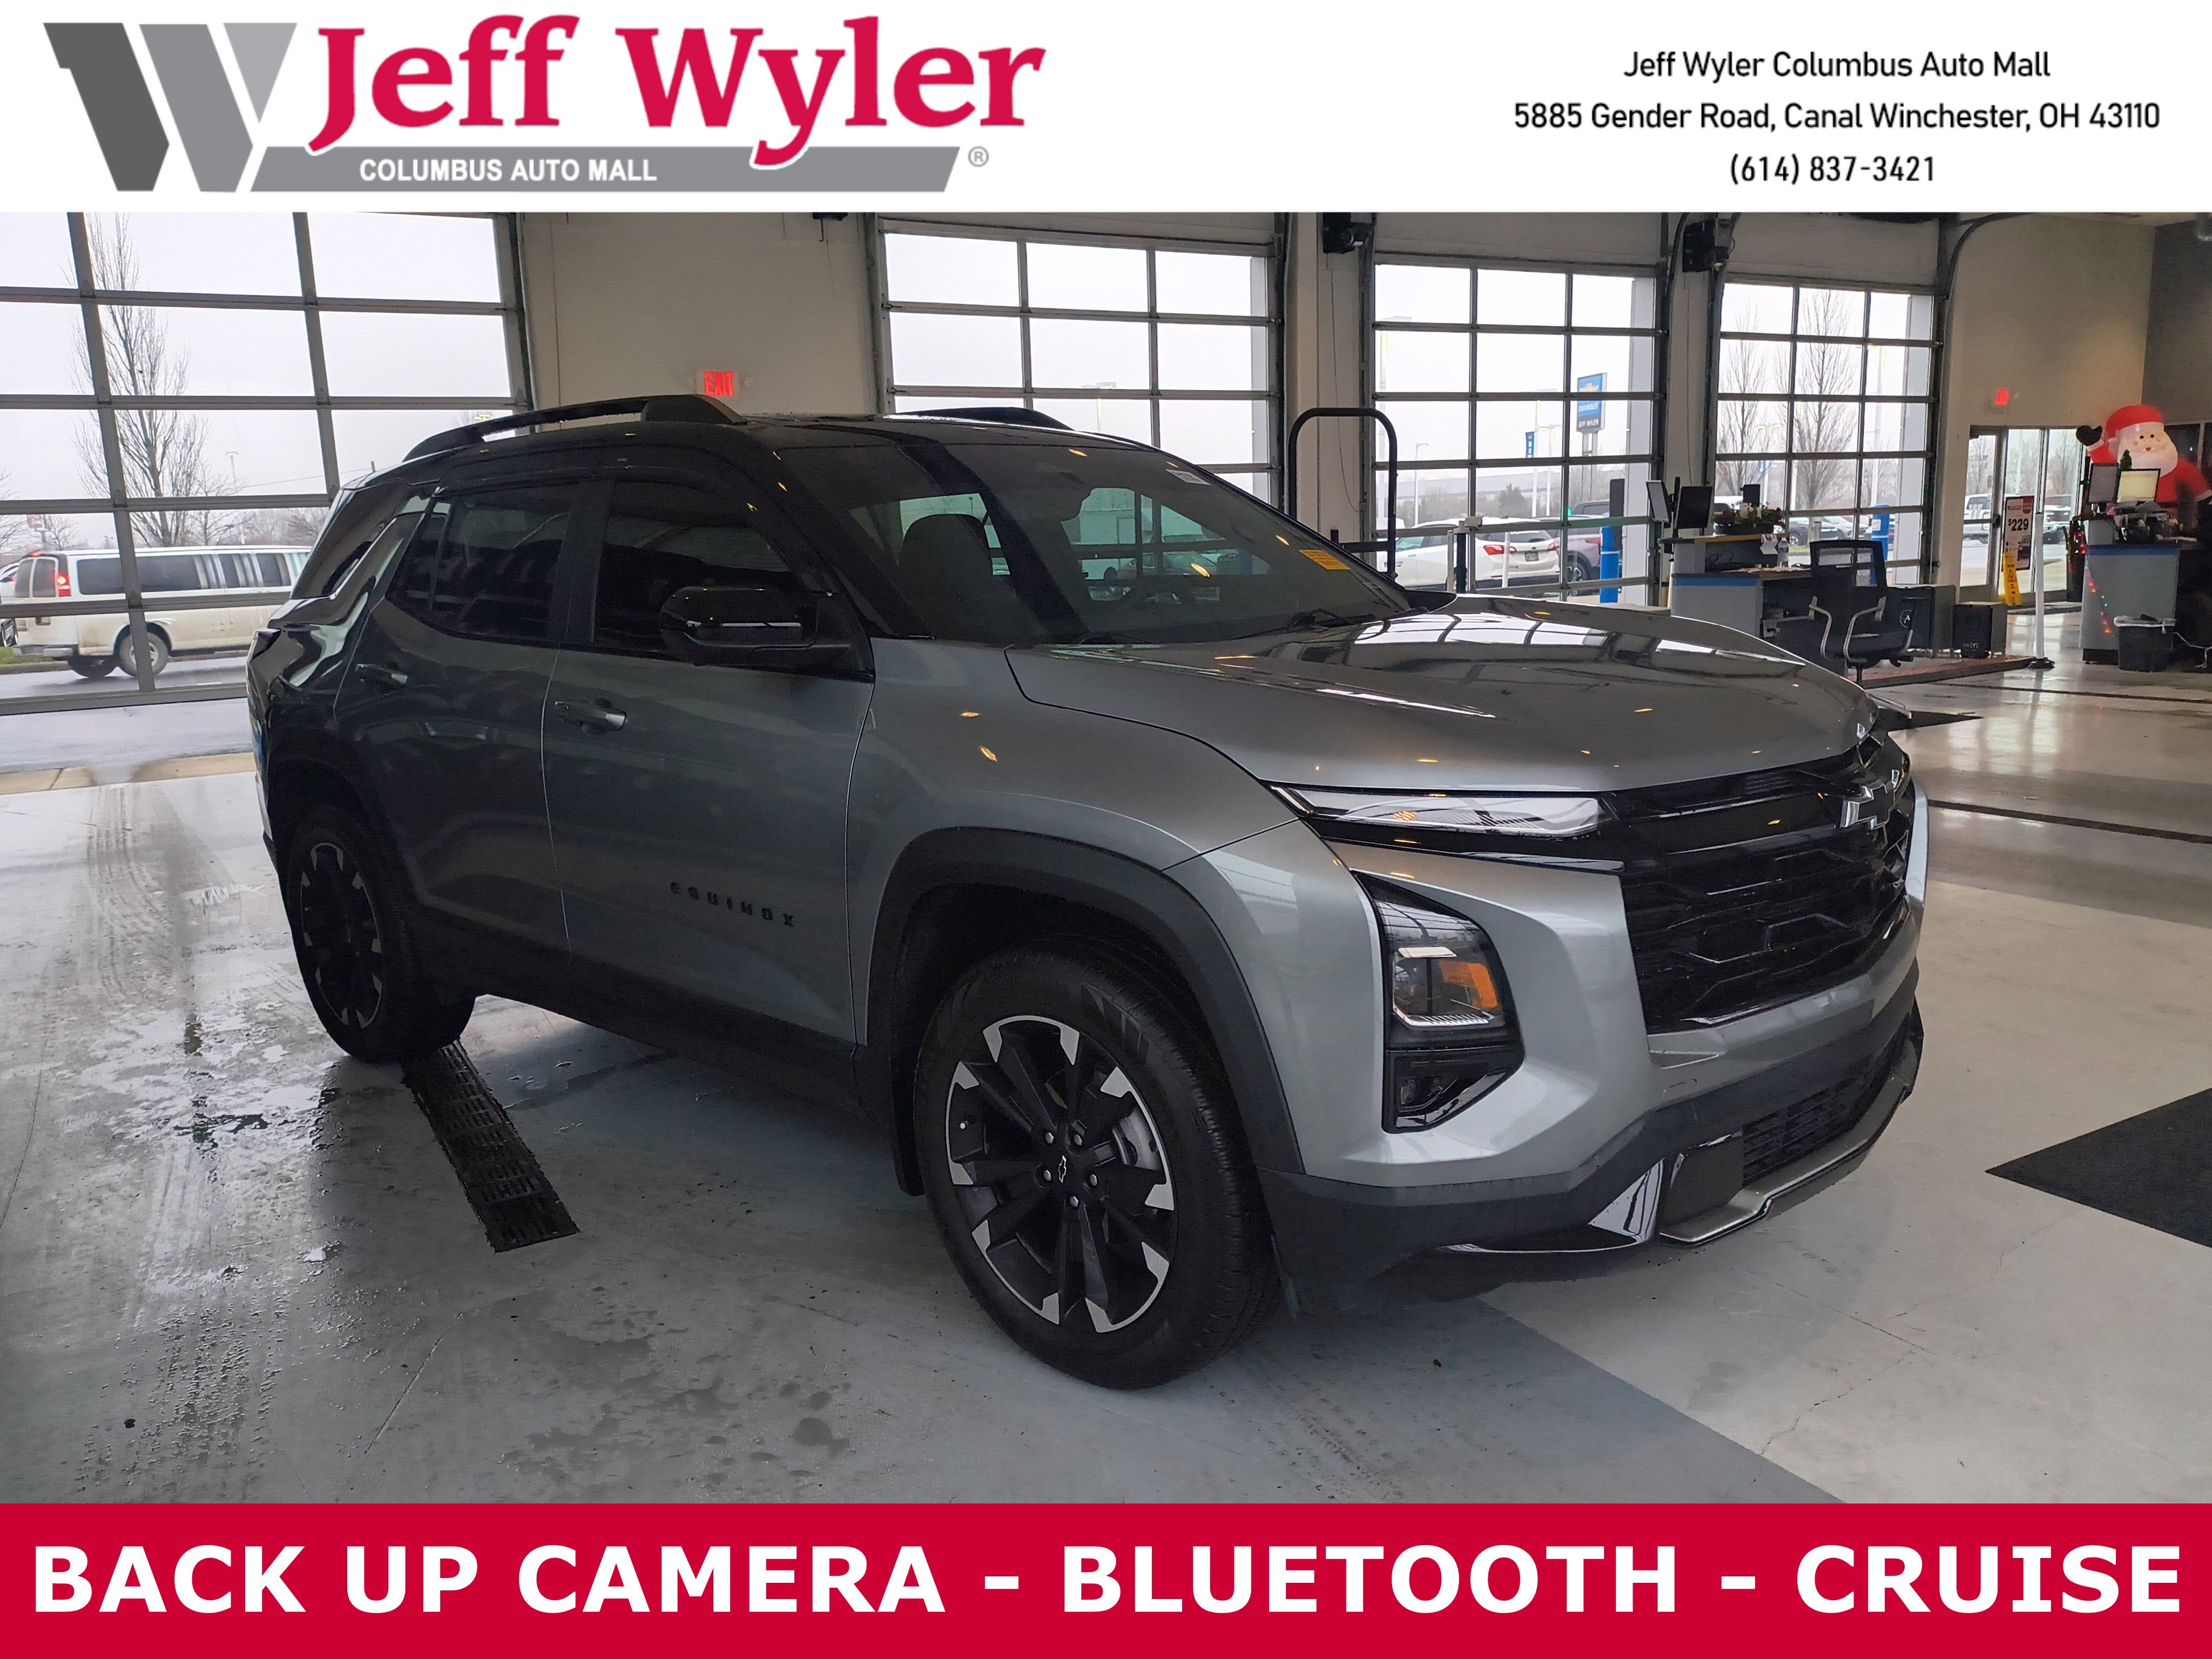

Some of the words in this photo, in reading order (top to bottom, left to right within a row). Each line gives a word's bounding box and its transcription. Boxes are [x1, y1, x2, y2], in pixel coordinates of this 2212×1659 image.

[704, 372, 734, 396] EXIT
[2007, 518, 2029, 531] $229
[670, 881, 795, 928] EQUINOX
